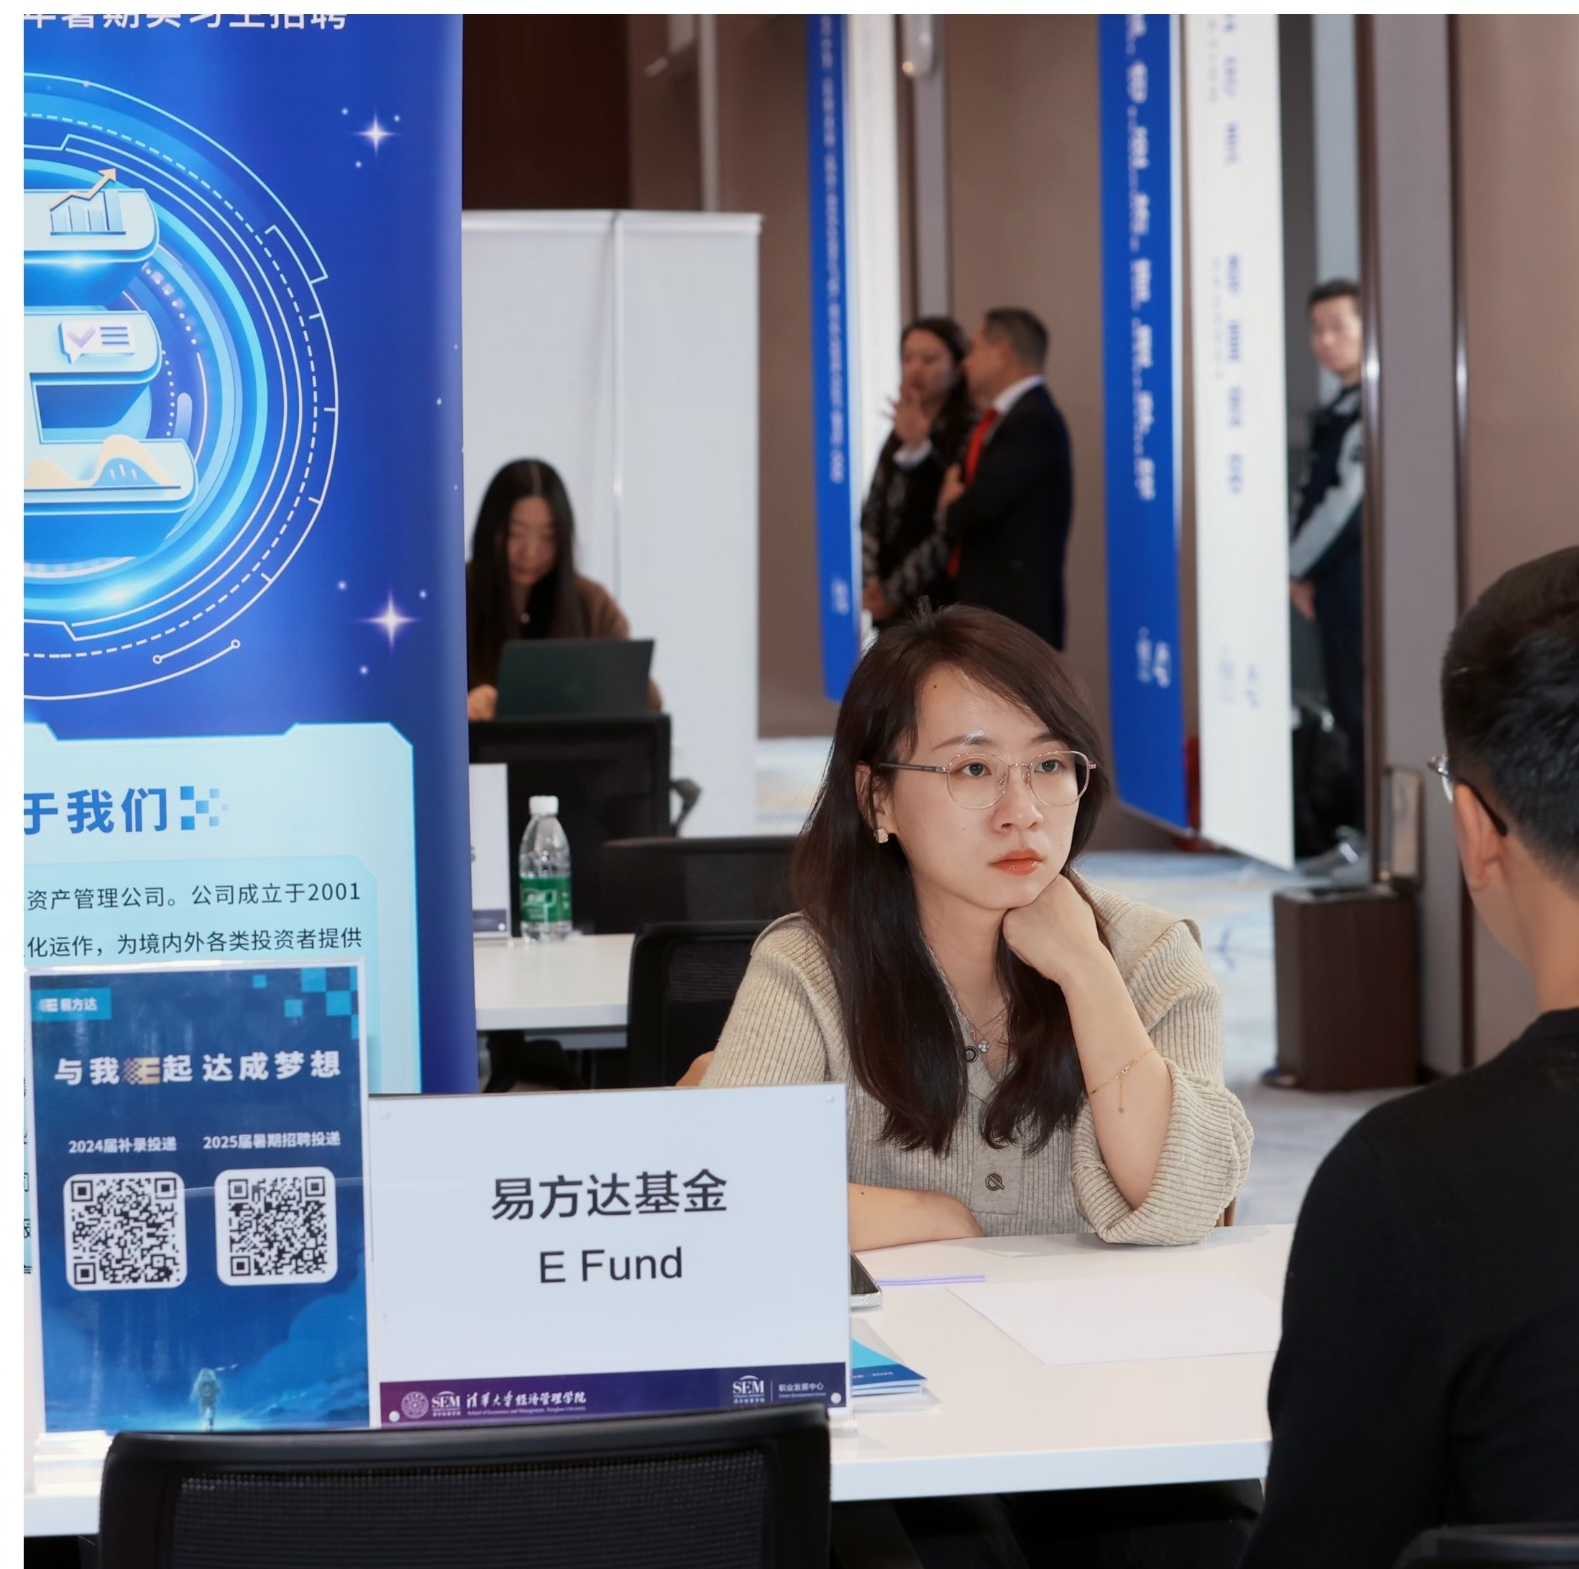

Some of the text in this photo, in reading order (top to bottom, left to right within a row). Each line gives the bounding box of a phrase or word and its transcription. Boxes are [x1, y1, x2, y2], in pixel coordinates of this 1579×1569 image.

[202, 1050, 342, 1083] 达成梦想
[68, 1135, 178, 1154] 2024届补录投递
[203, 1130, 342, 1150] 2025届暑期招聘投递
[491, 1168, 728, 1221] 易方达基金
[539, 1246, 684, 1284] E Fund
[733, 1379, 765, 1394] SEM
[431, 1394, 461, 1409] SEM
